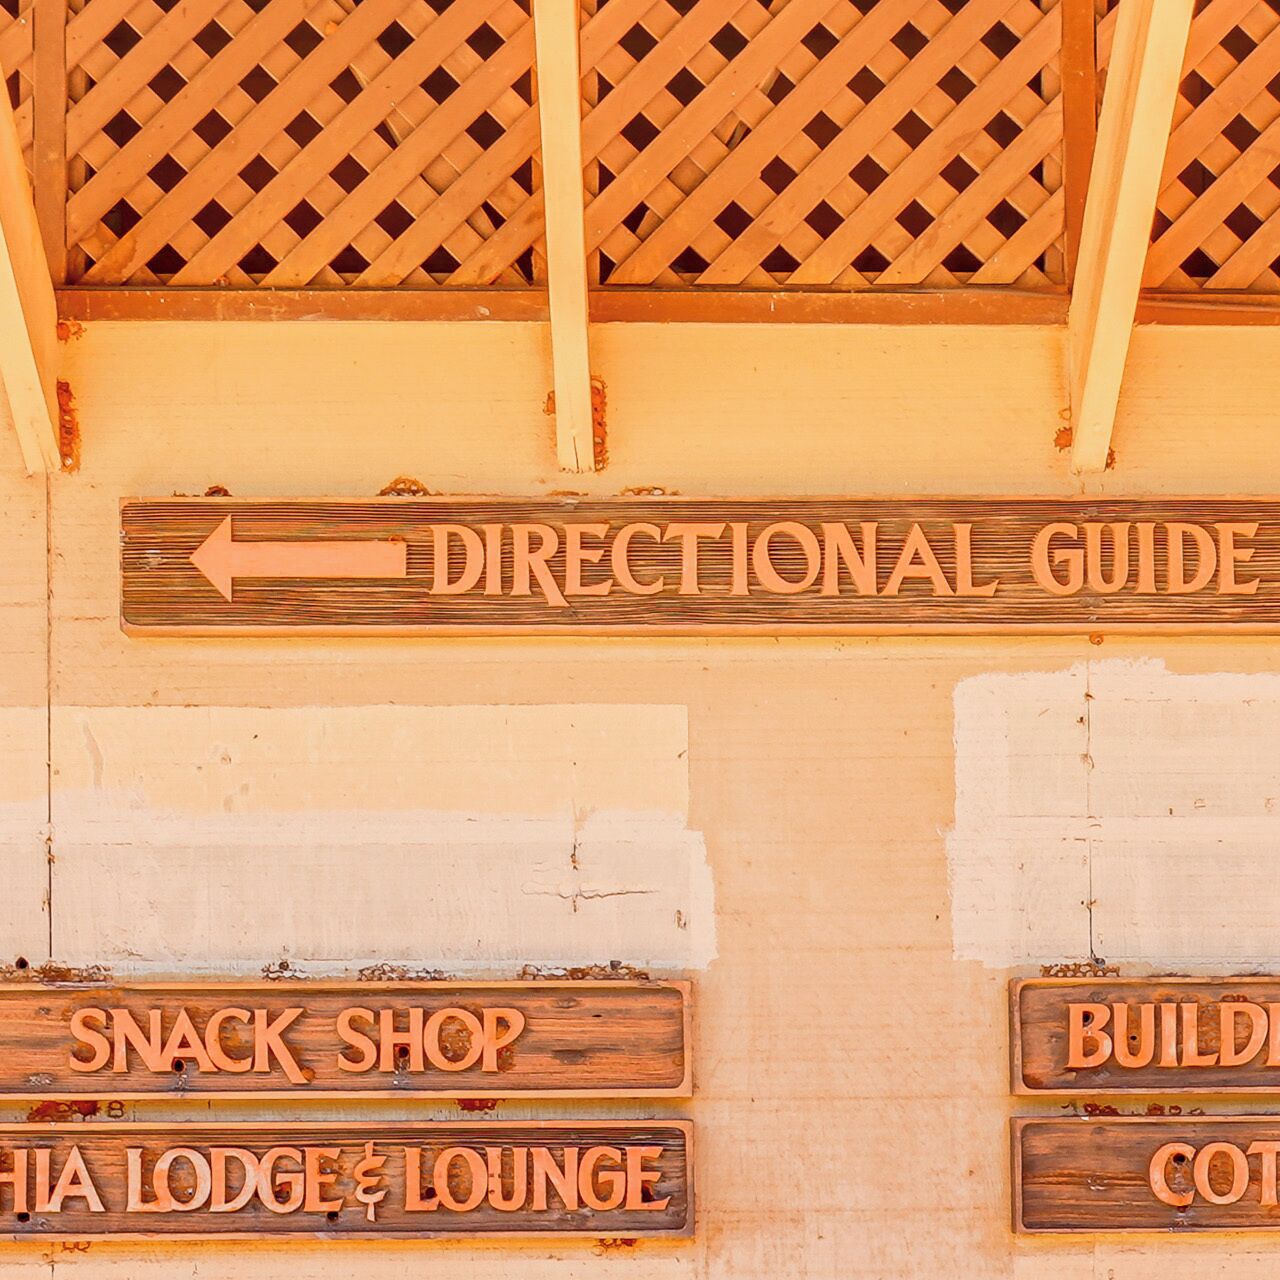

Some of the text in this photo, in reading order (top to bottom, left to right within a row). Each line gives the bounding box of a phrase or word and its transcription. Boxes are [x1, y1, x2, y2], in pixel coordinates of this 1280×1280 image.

[428, 521, 1261, 607] DIRECTIONAL GUIDE
[68, 1006, 526, 1084] SNACK SHOP
[125, 1145, 343, 1214] LODGE
[353, 1140, 388, 1222] &
[404, 1145, 673, 1214] LOUNGE
